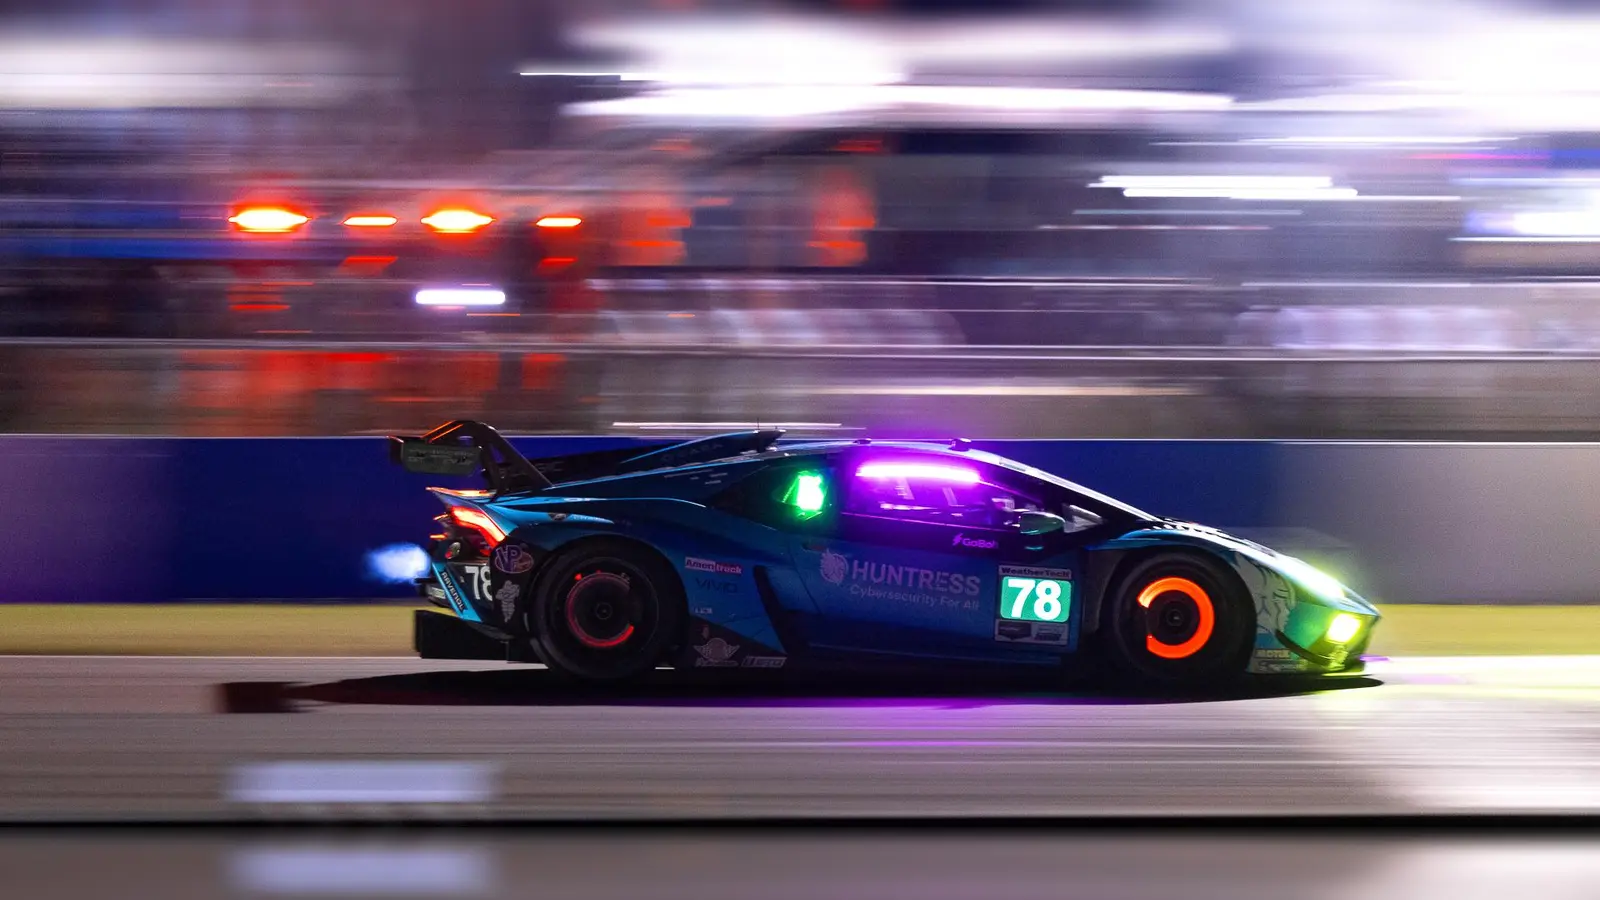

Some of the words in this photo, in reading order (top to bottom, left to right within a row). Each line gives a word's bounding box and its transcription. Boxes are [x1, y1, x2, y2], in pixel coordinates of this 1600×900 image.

[465, 566, 493, 601] 78
[852, 560, 981, 596] HUNTRESS
[1001, 567, 1070, 577] WeatherTech
[441, 571, 466, 610] RAVENOL
[850, 584, 936, 607] Cybersecurity
[940, 597, 960, 608] For
[963, 600, 980, 611] All
[1008, 579, 1062, 620] 78
